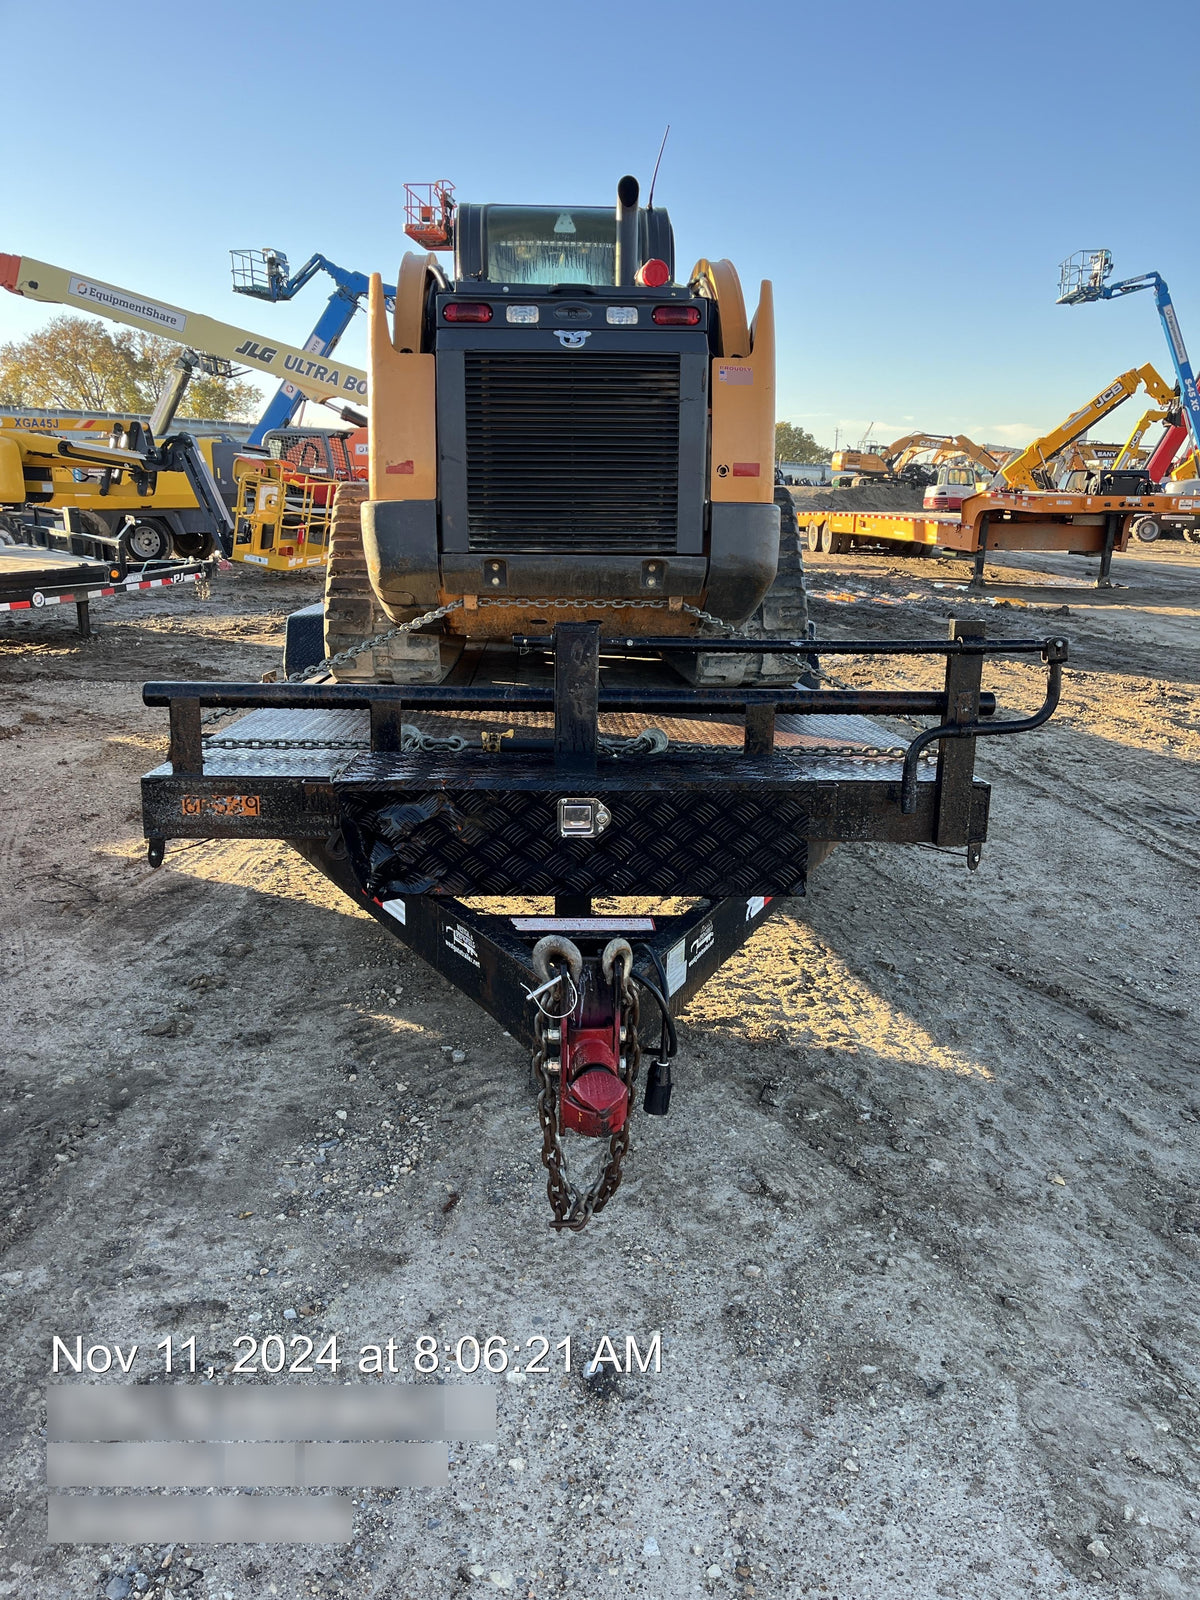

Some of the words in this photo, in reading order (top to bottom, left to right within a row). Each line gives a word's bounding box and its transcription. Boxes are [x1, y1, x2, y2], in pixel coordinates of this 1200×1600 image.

[89, 287, 177, 325] EquipmentShare
[235, 340, 277, 363] JLG
[283, 354, 339, 386] ULTRA
[343, 375, 368, 395] BO
[1095, 382, 1123, 409] JCB
[14, 417, 59, 429] XGA45J
[919, 440, 942, 449] CASE
[1097, 450, 1117, 458] SANY
[173, 573, 185, 582] PJ
